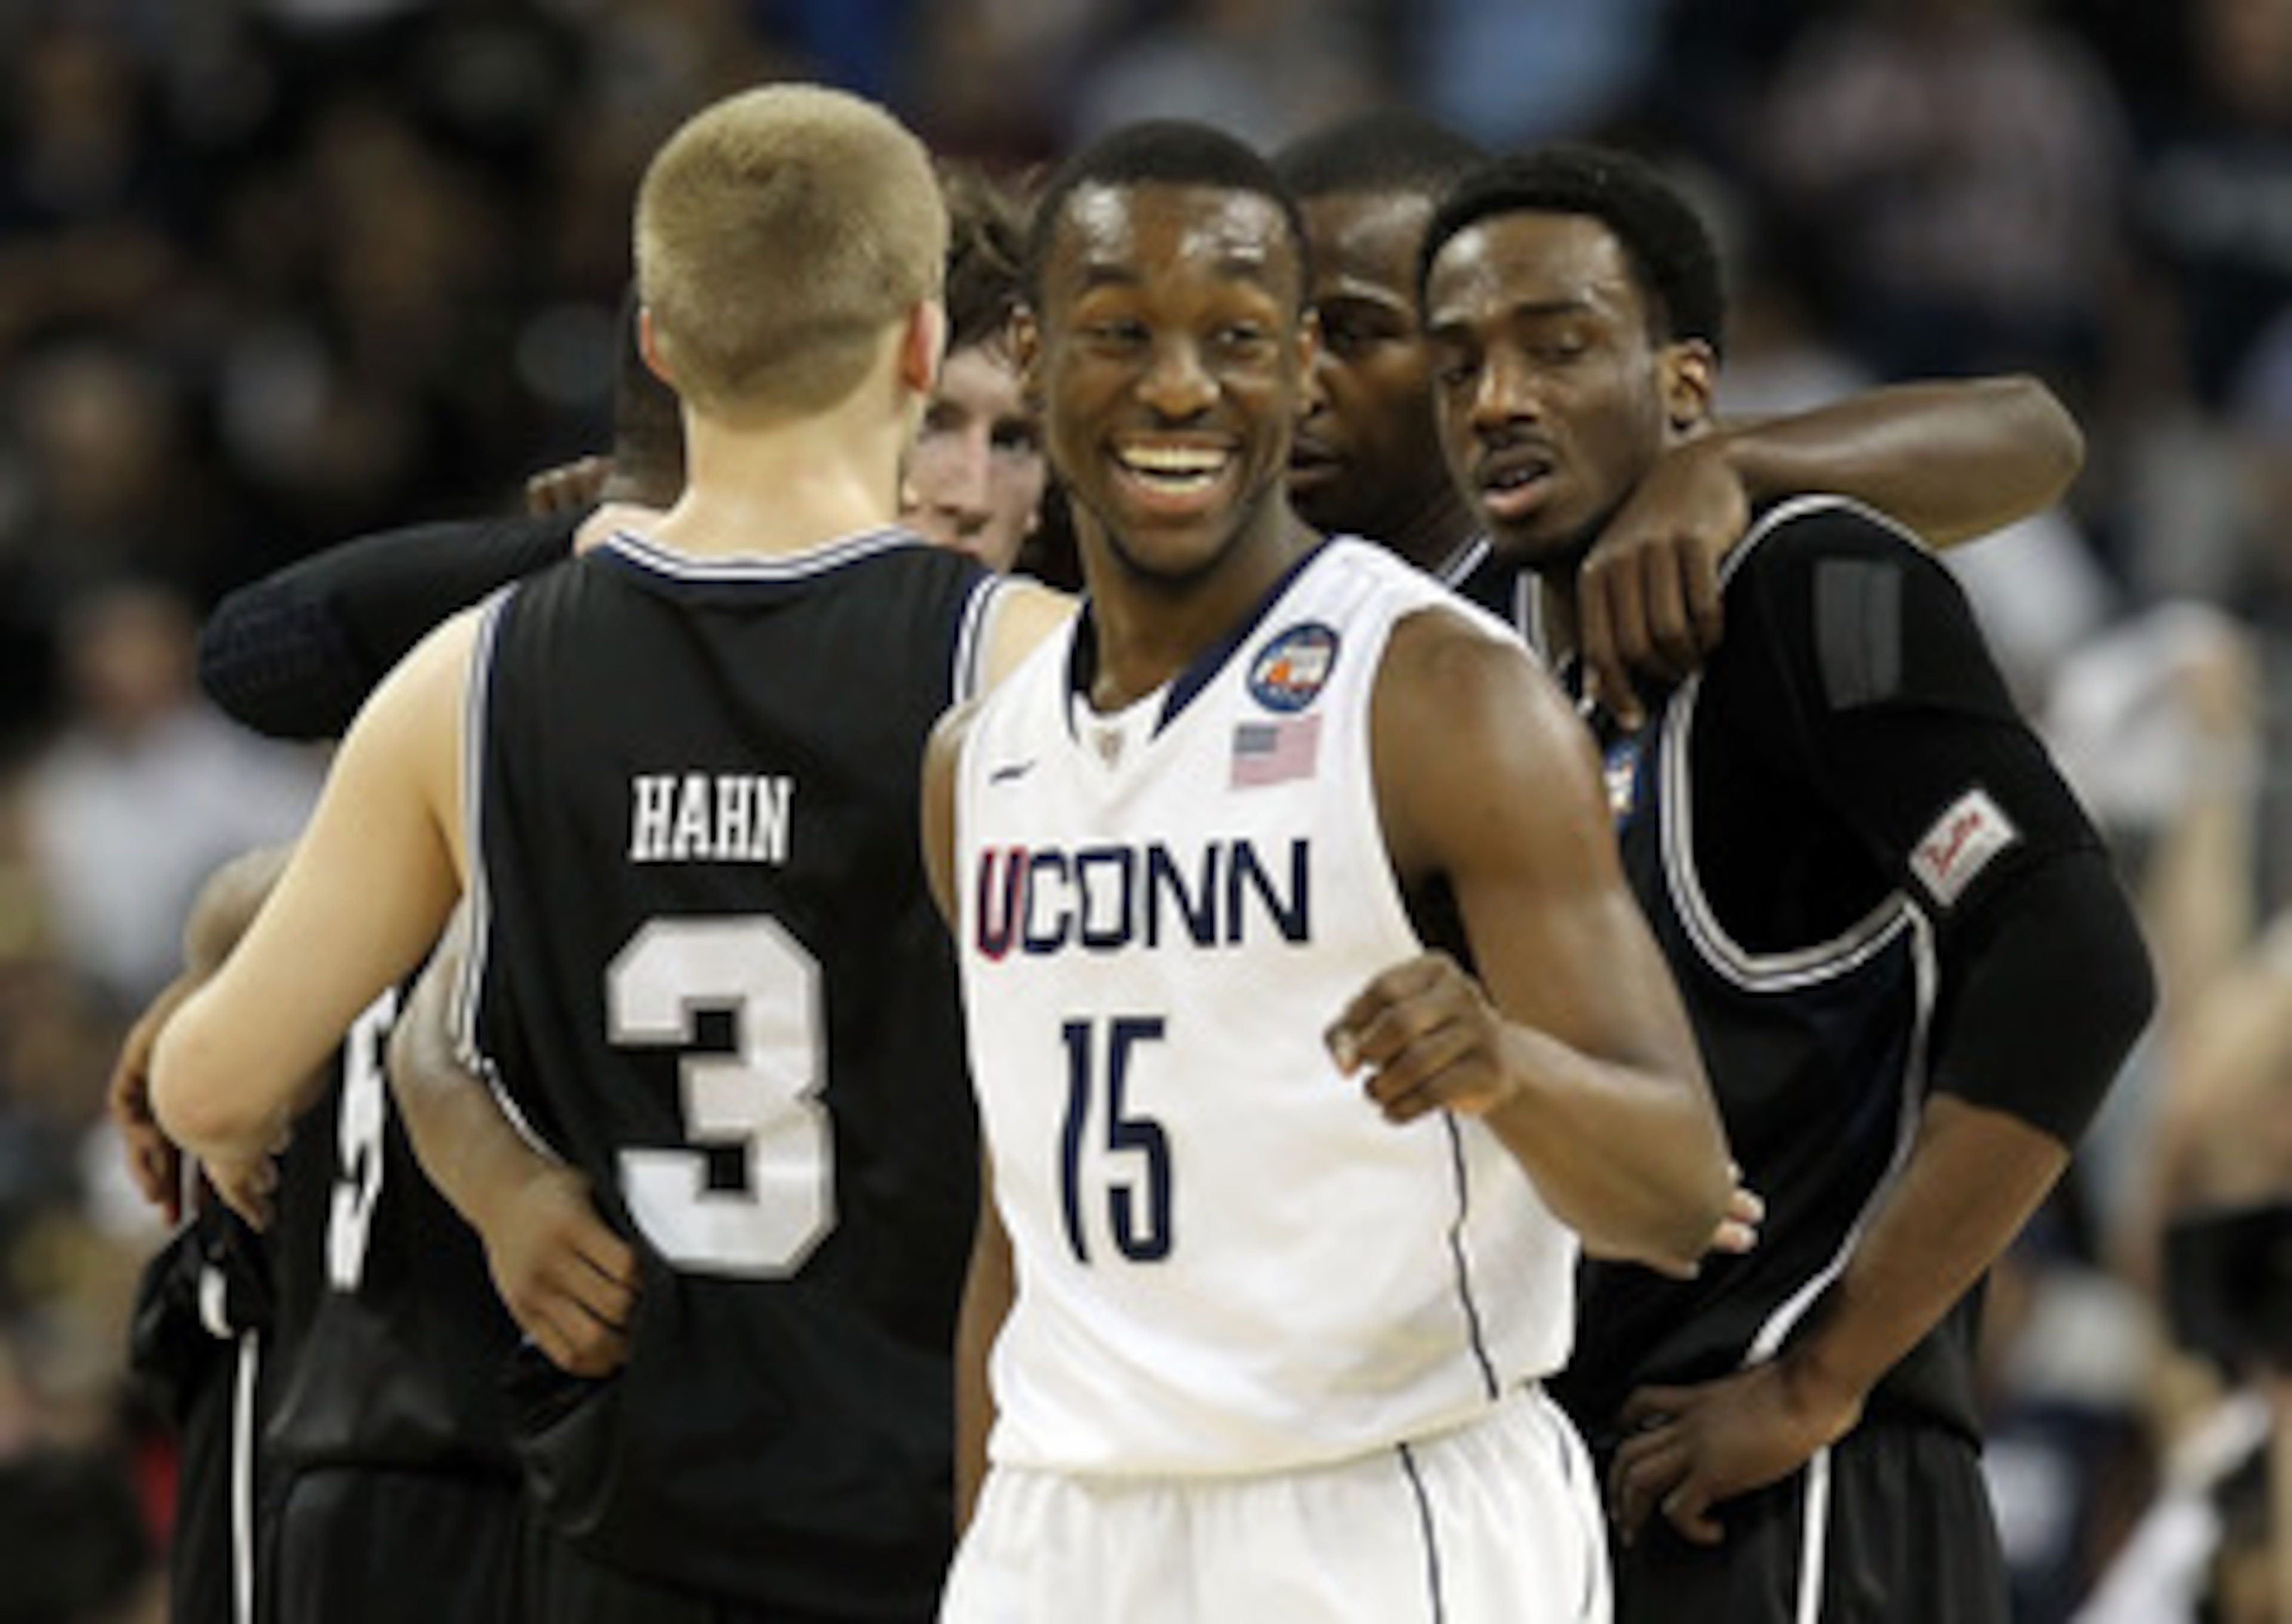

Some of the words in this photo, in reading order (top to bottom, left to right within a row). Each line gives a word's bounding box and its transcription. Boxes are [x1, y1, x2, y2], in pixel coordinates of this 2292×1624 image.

[630, 774, 794, 863] HAHN
[978, 838, 1310, 962] UCONN
[606, 914, 837, 1280] 3
[1058, 1016, 1173, 1265] 15
